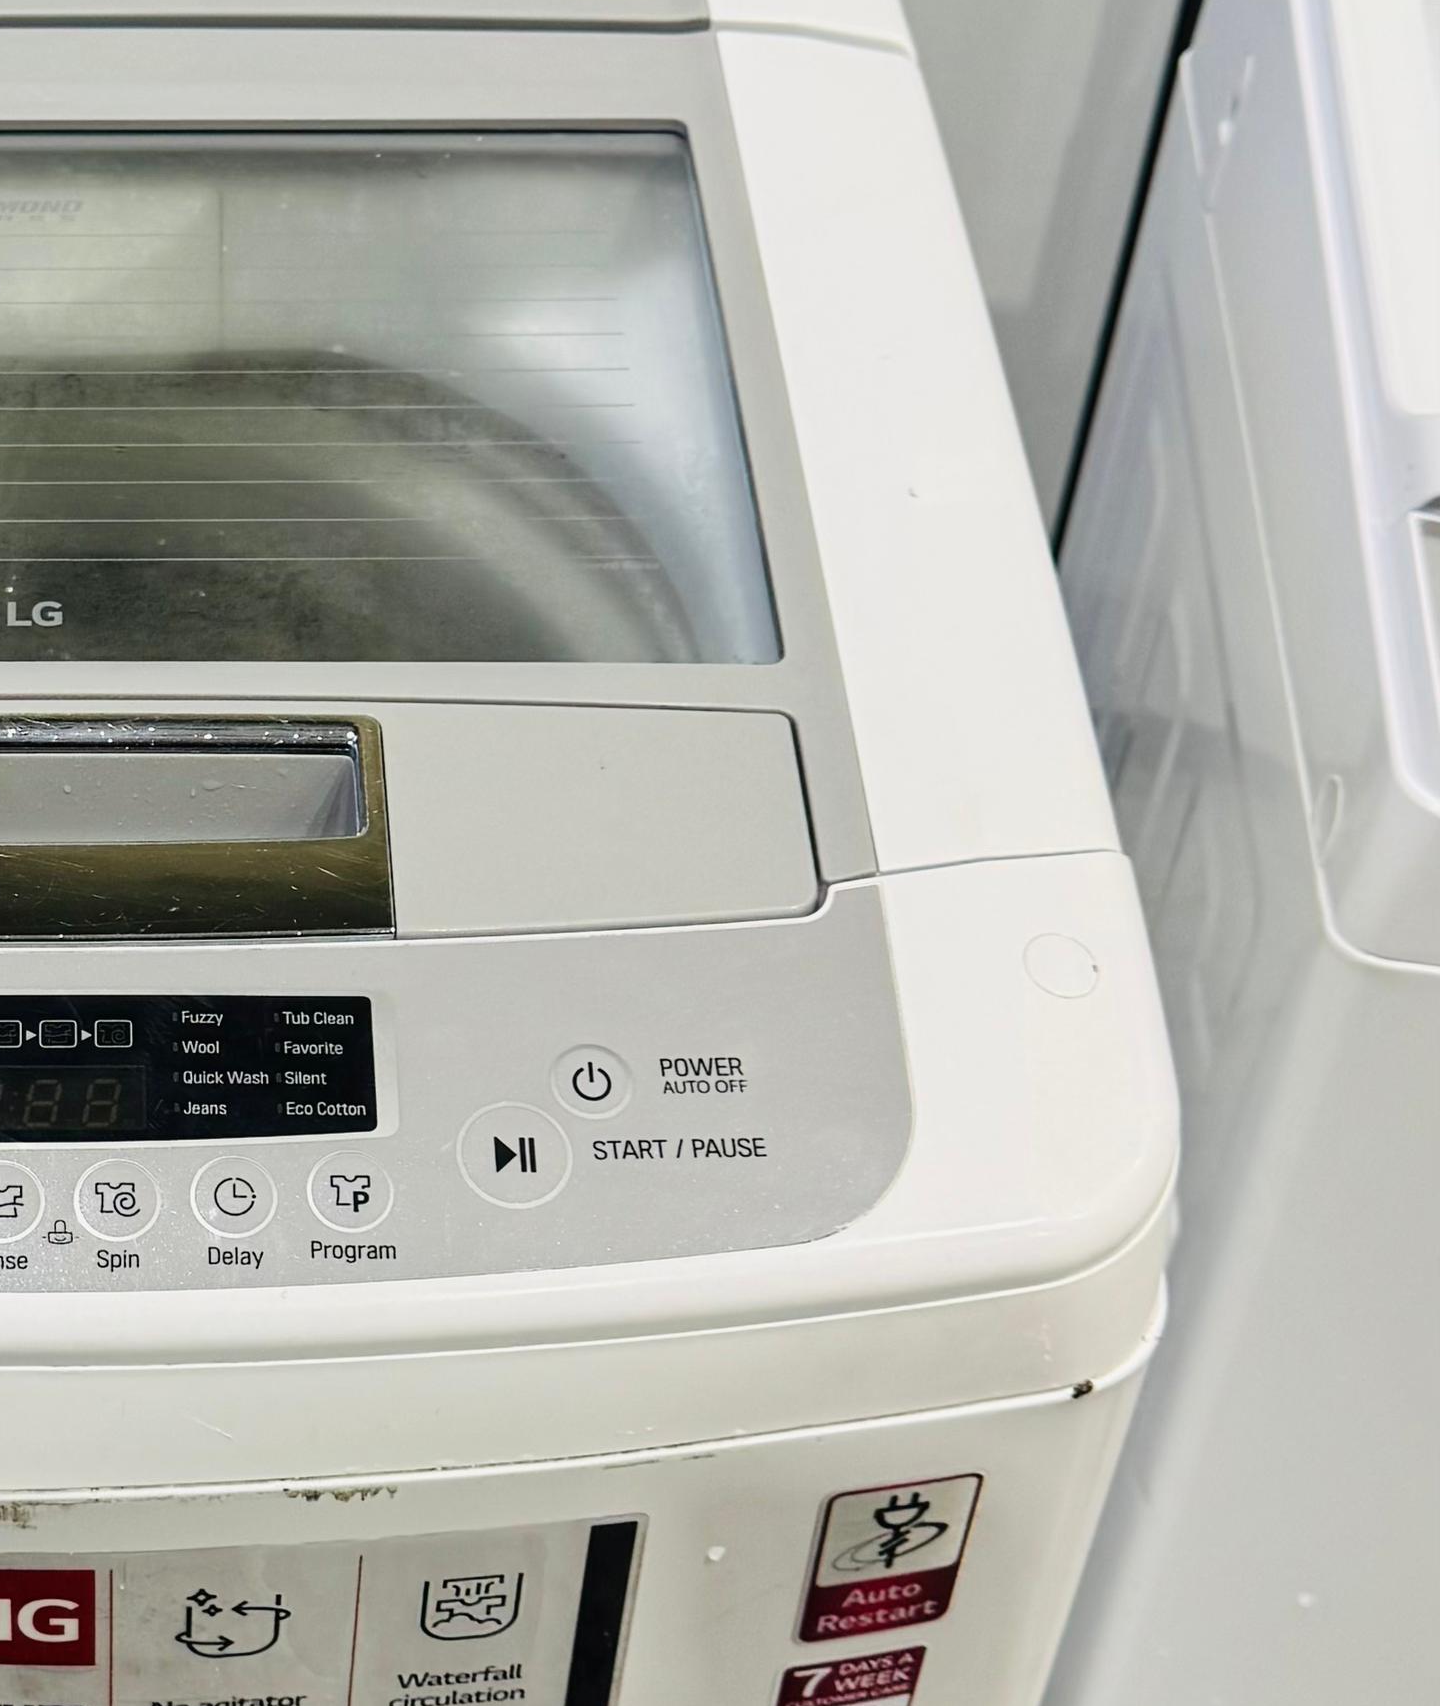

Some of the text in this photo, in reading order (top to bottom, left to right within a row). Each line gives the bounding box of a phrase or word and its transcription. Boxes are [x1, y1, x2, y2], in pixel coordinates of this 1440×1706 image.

[6, 600, 64, 628] LG
[181, 1010, 224, 1026] Fuzzy
[282, 1011, 355, 1026] Tub Clean
[182, 1040, 220, 1055] Wool
[283, 1040, 344, 1055] Favorite
[659, 1056, 745, 1077] POWER
[182, 1070, 270, 1086] Quick Wash
[284, 1070, 328, 1086] Silent
[662, 1079, 749, 1094] AUTO OFF
[183, 1101, 227, 1117] Jeans
[285, 1101, 367, 1117] Eco Cotton
[592, 1139, 668, 1161] START
[691, 1137, 768, 1159] PAUSE
[96, 1249, 141, 1272] Spin
[207, 1246, 264, 1269] Delay
[309, 1240, 397, 1262] Program
[841, 1582, 923, 1609] Auto
[816, 1599, 939, 1634] Restart
[396, 1663, 523, 1690] Waterfall
[792, 1652, 915, 1698] 7 DAYS A
[833, 1667, 913, 1693] WEEK
